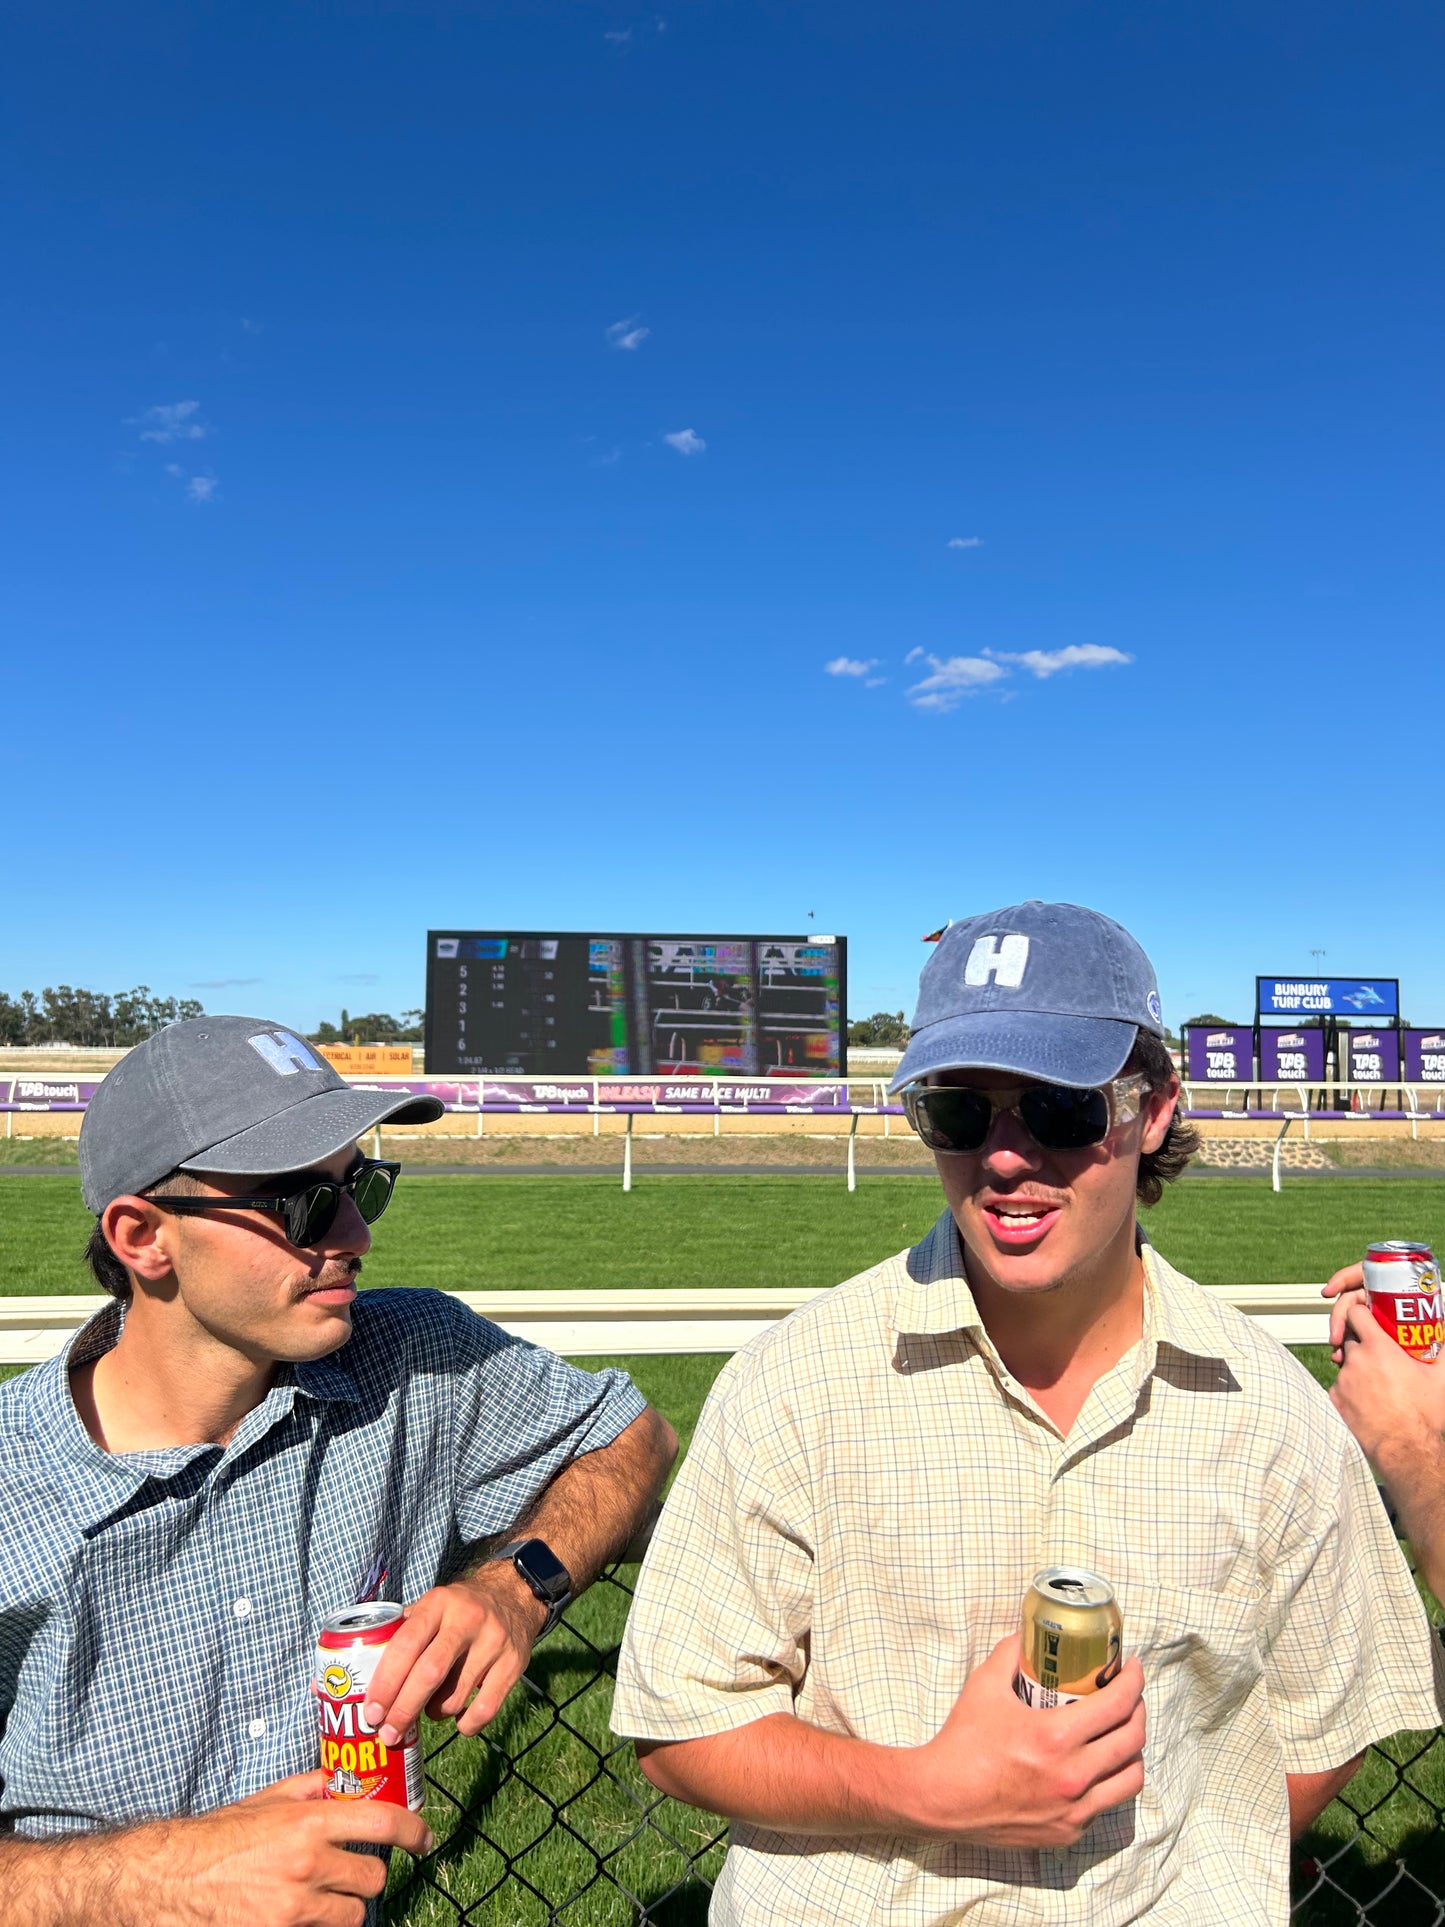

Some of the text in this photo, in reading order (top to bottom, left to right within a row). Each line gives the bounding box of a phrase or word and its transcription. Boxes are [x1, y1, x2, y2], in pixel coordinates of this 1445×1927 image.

[964, 934, 1030, 987] H
[460, 965, 468, 978] 5
[459, 983, 468, 996] 2
[1274, 983, 1328, 996] BUNBURY
[459, 1002, 467, 1014] 3
[1271, 996, 1332, 1010] TURF CLUB
[459, 1019, 466, 1032] 1
[458, 1038, 466, 1051] 6
[248, 1032, 323, 1076] H
[1206, 1052, 1235, 1068] TAB
[1277, 1053, 1305, 1068] TAB
[1352, 1054, 1380, 1070] TAB
[1207, 1068, 1235, 1079] touch
[1277, 1068, 1305, 1079] touch
[1353, 1069, 1380, 1080] touch
[18, 1083, 77, 1097] TABtouch
[532, 1085, 589, 1099] TABtouch
[665, 1087, 699, 1099] SAME
[701, 1087, 733, 1099] RACE
[734, 1087, 770, 1099] MULTI
[362, 1776, 389, 1801] STRALIA
